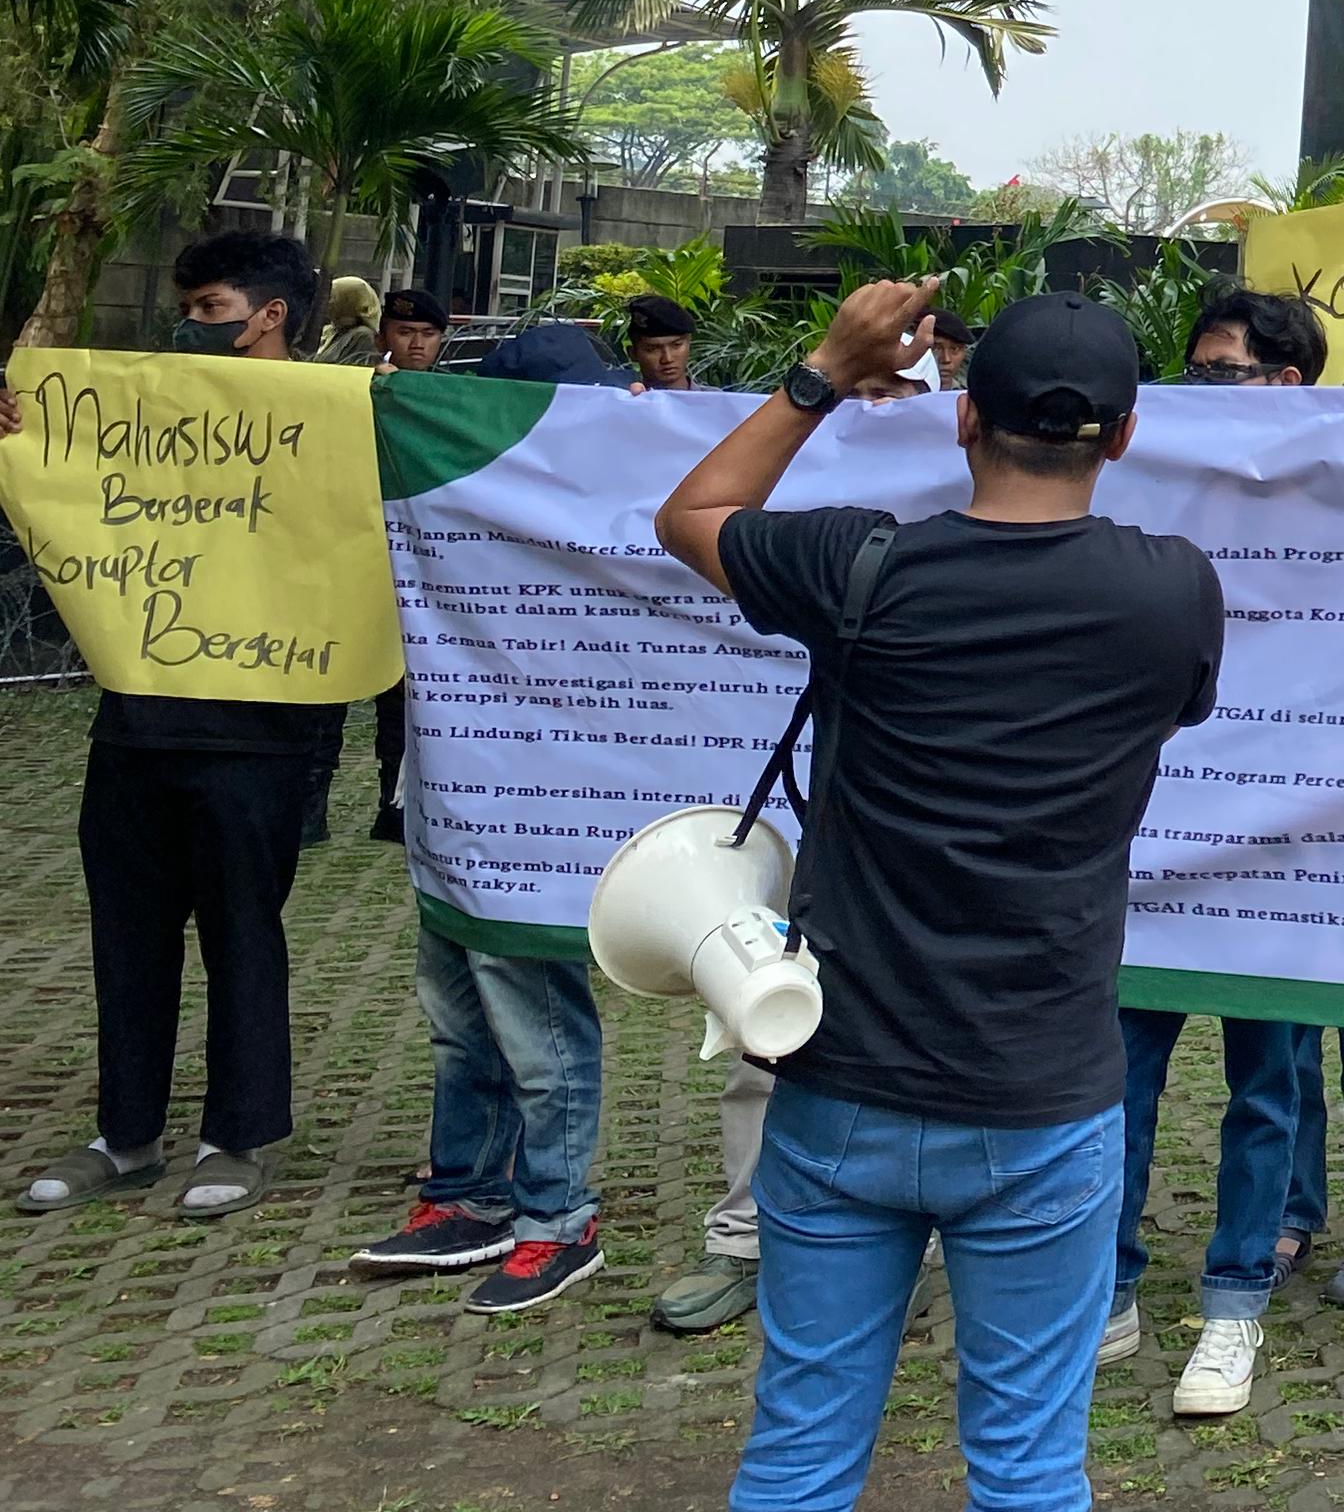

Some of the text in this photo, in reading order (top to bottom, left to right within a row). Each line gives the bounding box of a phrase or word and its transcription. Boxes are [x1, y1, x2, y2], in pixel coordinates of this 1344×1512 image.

[421, 581, 512, 596] menuntut
[518, 584, 563, 596] KPK
[436, 600, 508, 616] terlibat
[515, 604, 578, 617] dalam
[584, 604, 641, 617] kasus
[436, 633, 497, 649] Semua
[502, 638, 566, 652] Tabir!
[572, 640, 630, 653] Audit
[637, 641, 707, 654] Tuntas
[713, 643, 808, 659] Anggaran
[468, 670, 520, 685] audit
[526, 674, 634, 692] investigasi
[641, 680, 768, 696] menyeluruh
[426, 690, 508, 705] korupsi
[514, 695, 563, 708] yang
[568, 695, 621, 709] lebih
[628, 697, 674, 710] luas.
[1270, 710, 1291, 723] di
[449, 726, 543, 743] Lindungi
[549, 729, 608, 743] Tikus
[614, 732, 697, 747] Berdasi!
[703, 735, 746, 749] DPR
[751, 739, 812, 752] Haus
[1200, 767, 1286, 785] Program
[493, 785, 627, 801] pembersihan
[632, 789, 714, 805] internal
[722, 793, 741, 806] di
[443, 817, 507, 835] Rakyat
[513, 823, 579, 837] Bukan
[466, 858, 604, 876] pengembalian
[1161, 868, 1285, 883] Percepatan
[472, 876, 542, 893] rakyat.
[1192, 904, 1229, 918] dan
